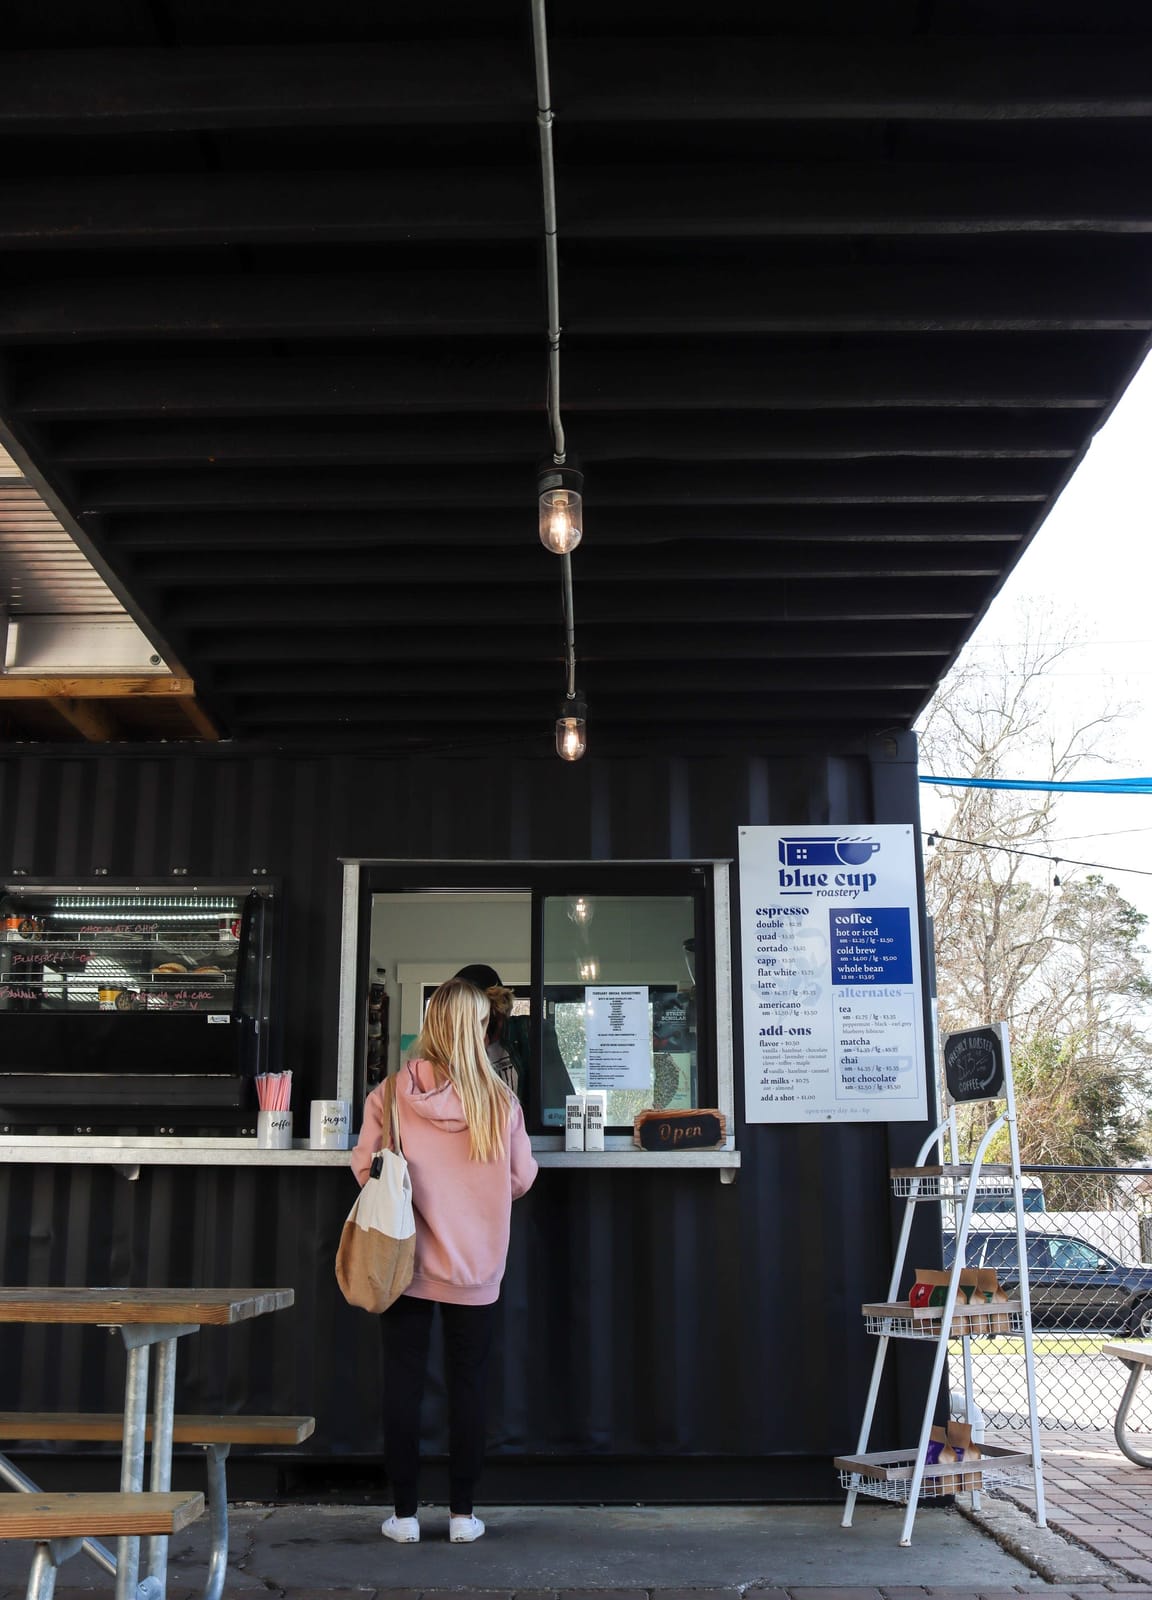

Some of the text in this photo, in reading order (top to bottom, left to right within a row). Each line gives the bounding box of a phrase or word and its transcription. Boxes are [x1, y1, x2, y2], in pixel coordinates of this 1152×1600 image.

[778, 868, 877, 891] blue cup
[816, 888, 860, 900] roastery
[756, 907, 809, 918] espresso
[835, 913, 872, 924] coffee
[80, 922, 159, 933] CHOCOLATE CHIP
[756, 920, 784, 928] double
[757, 932, 776, 942] quad
[836, 928, 850, 936] hot
[862, 928, 879, 936] iced
[757, 944, 788, 952] cortado
[837, 946, 876, 954] cold brew
[758, 958, 777, 966] capp
[758, 968, 771, 976] flat
[838, 988, 902, 998] alternates
[759, 1025, 812, 1036] add-ons
[840, 1037, 870, 1045] matcha
[948, 1038, 968, 1067] FRESHLY
[968, 1037, 993, 1052] ROASTED
[841, 1056, 858, 1064] chai
[959, 1078, 980, 1092] COFFEE
[659, 1124, 702, 1144] Open
